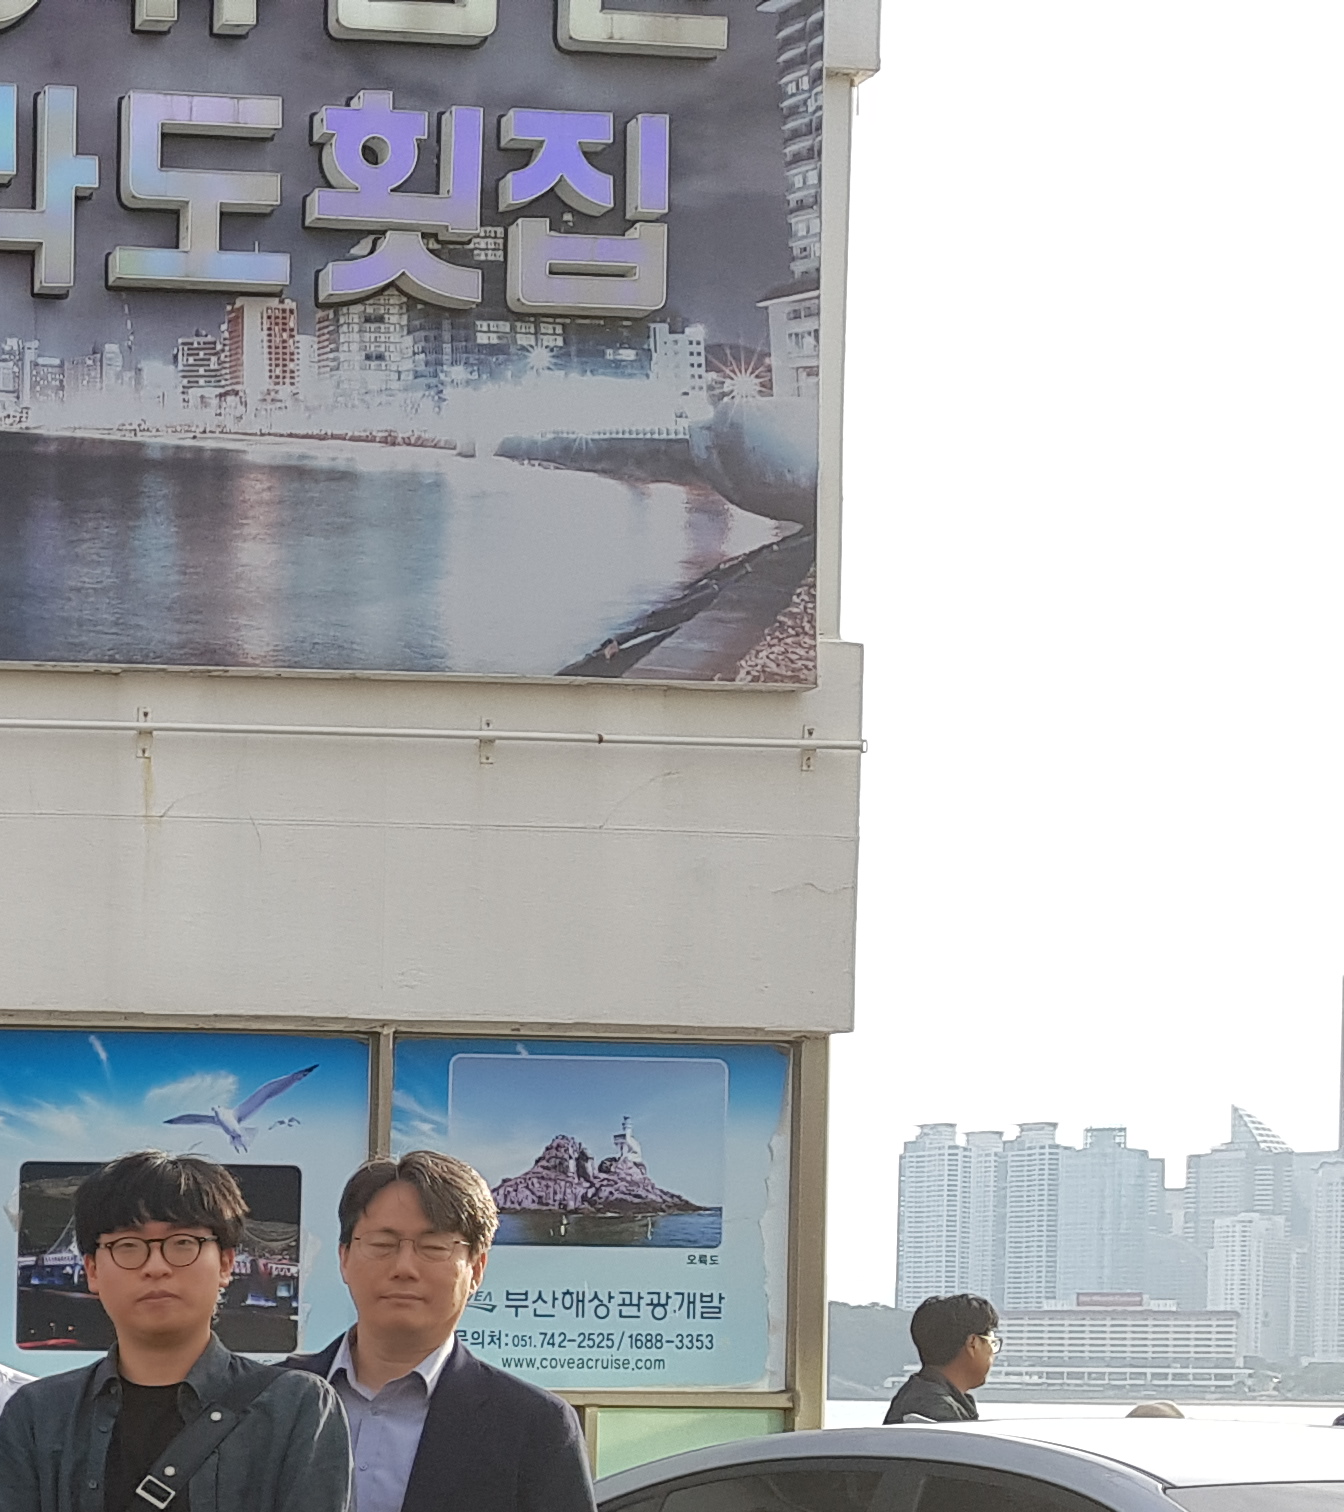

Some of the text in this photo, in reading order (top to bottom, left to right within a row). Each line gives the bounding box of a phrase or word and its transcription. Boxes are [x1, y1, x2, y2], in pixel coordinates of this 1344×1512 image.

[686, 1254, 720, 1266] 오륙도
[504, 1288, 726, 1321] 부산해상관광개발
[501, 1354, 666, 1372] www.coveacruise.com
